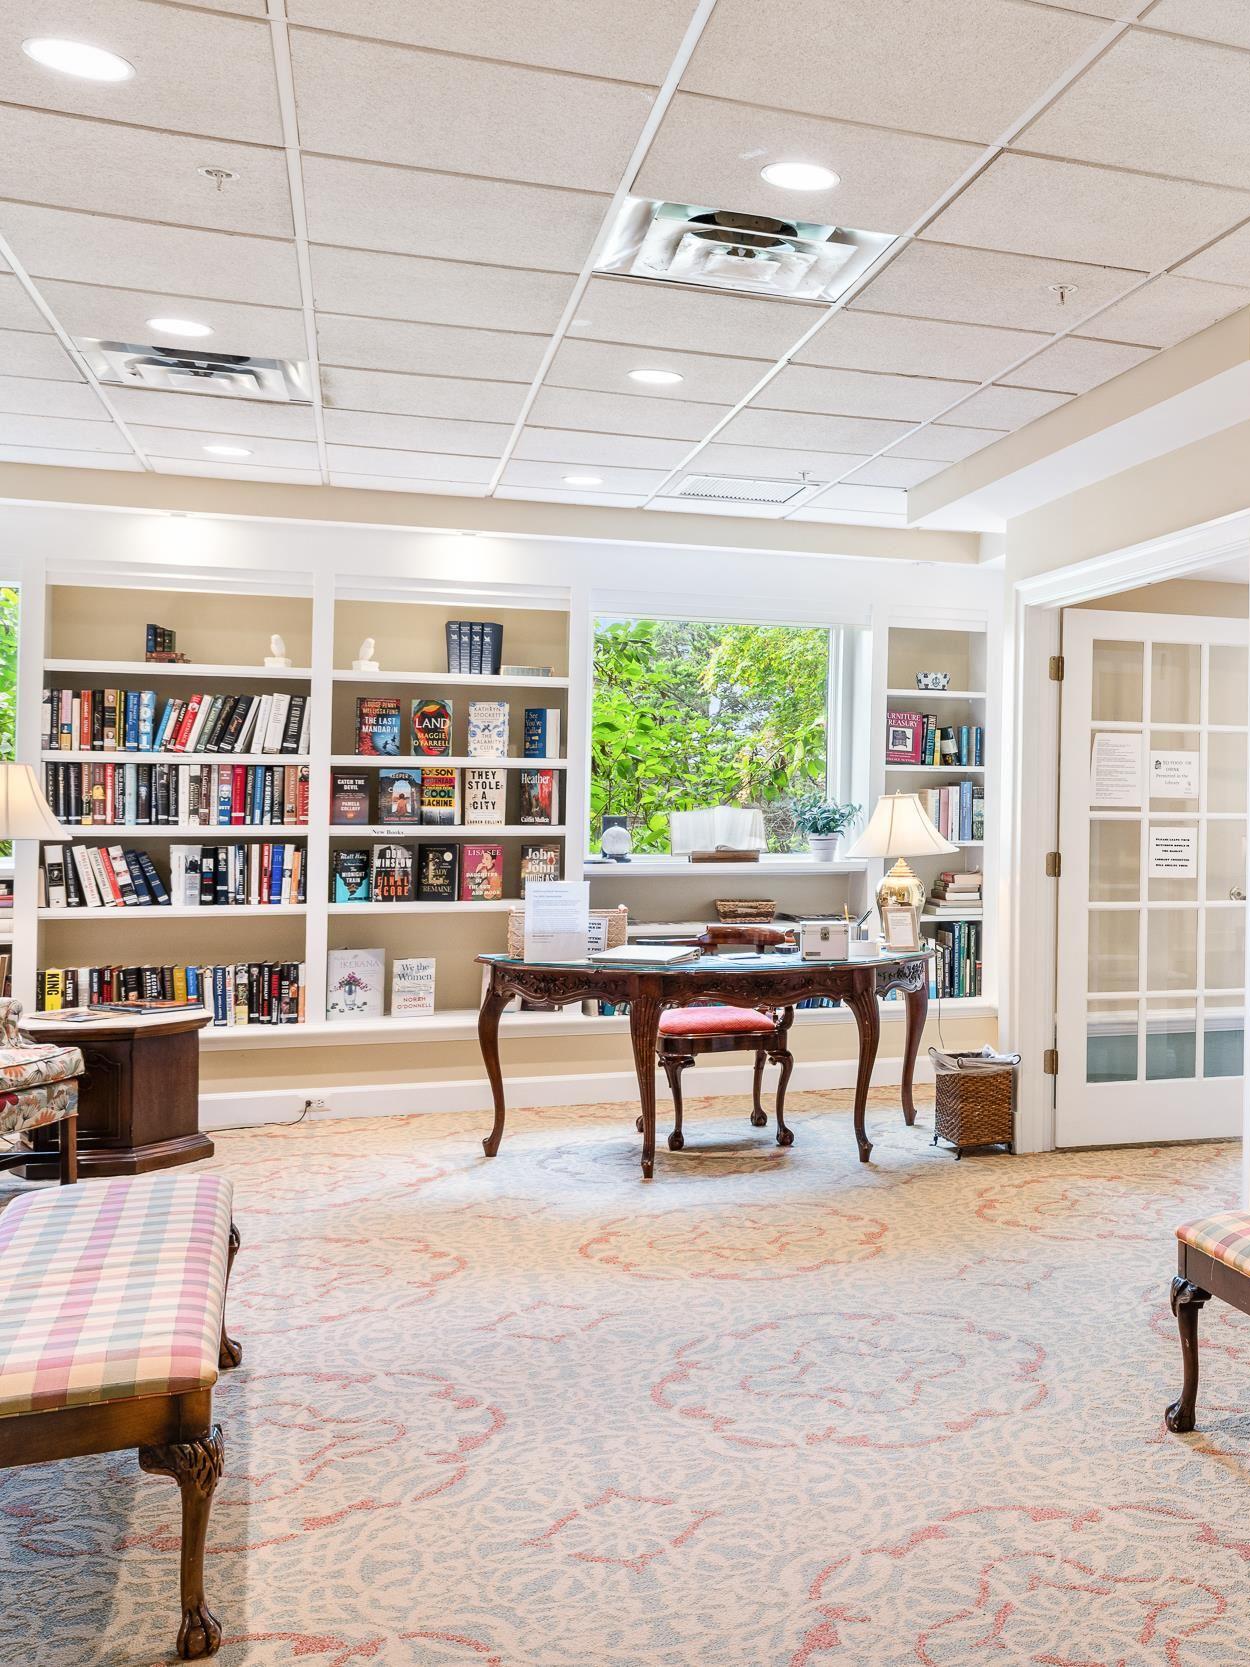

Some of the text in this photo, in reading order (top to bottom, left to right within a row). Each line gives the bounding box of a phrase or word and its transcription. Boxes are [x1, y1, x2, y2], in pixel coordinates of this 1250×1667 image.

[415, 718, 449, 728] LAND
[471, 771, 496, 779] THEY
[521, 773, 550, 784] Heather
[468, 781, 500, 789] STOLE
[424, 790, 452, 798] COOL
[481, 791, 487, 800] A
[473, 801, 496, 809] CITY
[385, 849, 401, 858] DON
[526, 849, 555, 859] John
[374, 859, 412, 867] WINSLOW
[526, 862, 555, 872] John
[377, 877, 409, 886] FINAL
[377, 886, 409, 895] SCORE
[417, 963, 430, 971] the
[397, 973, 432, 981] Women
[47, 973, 60, 995] KING
[281, 980, 289, 998] BIBI
